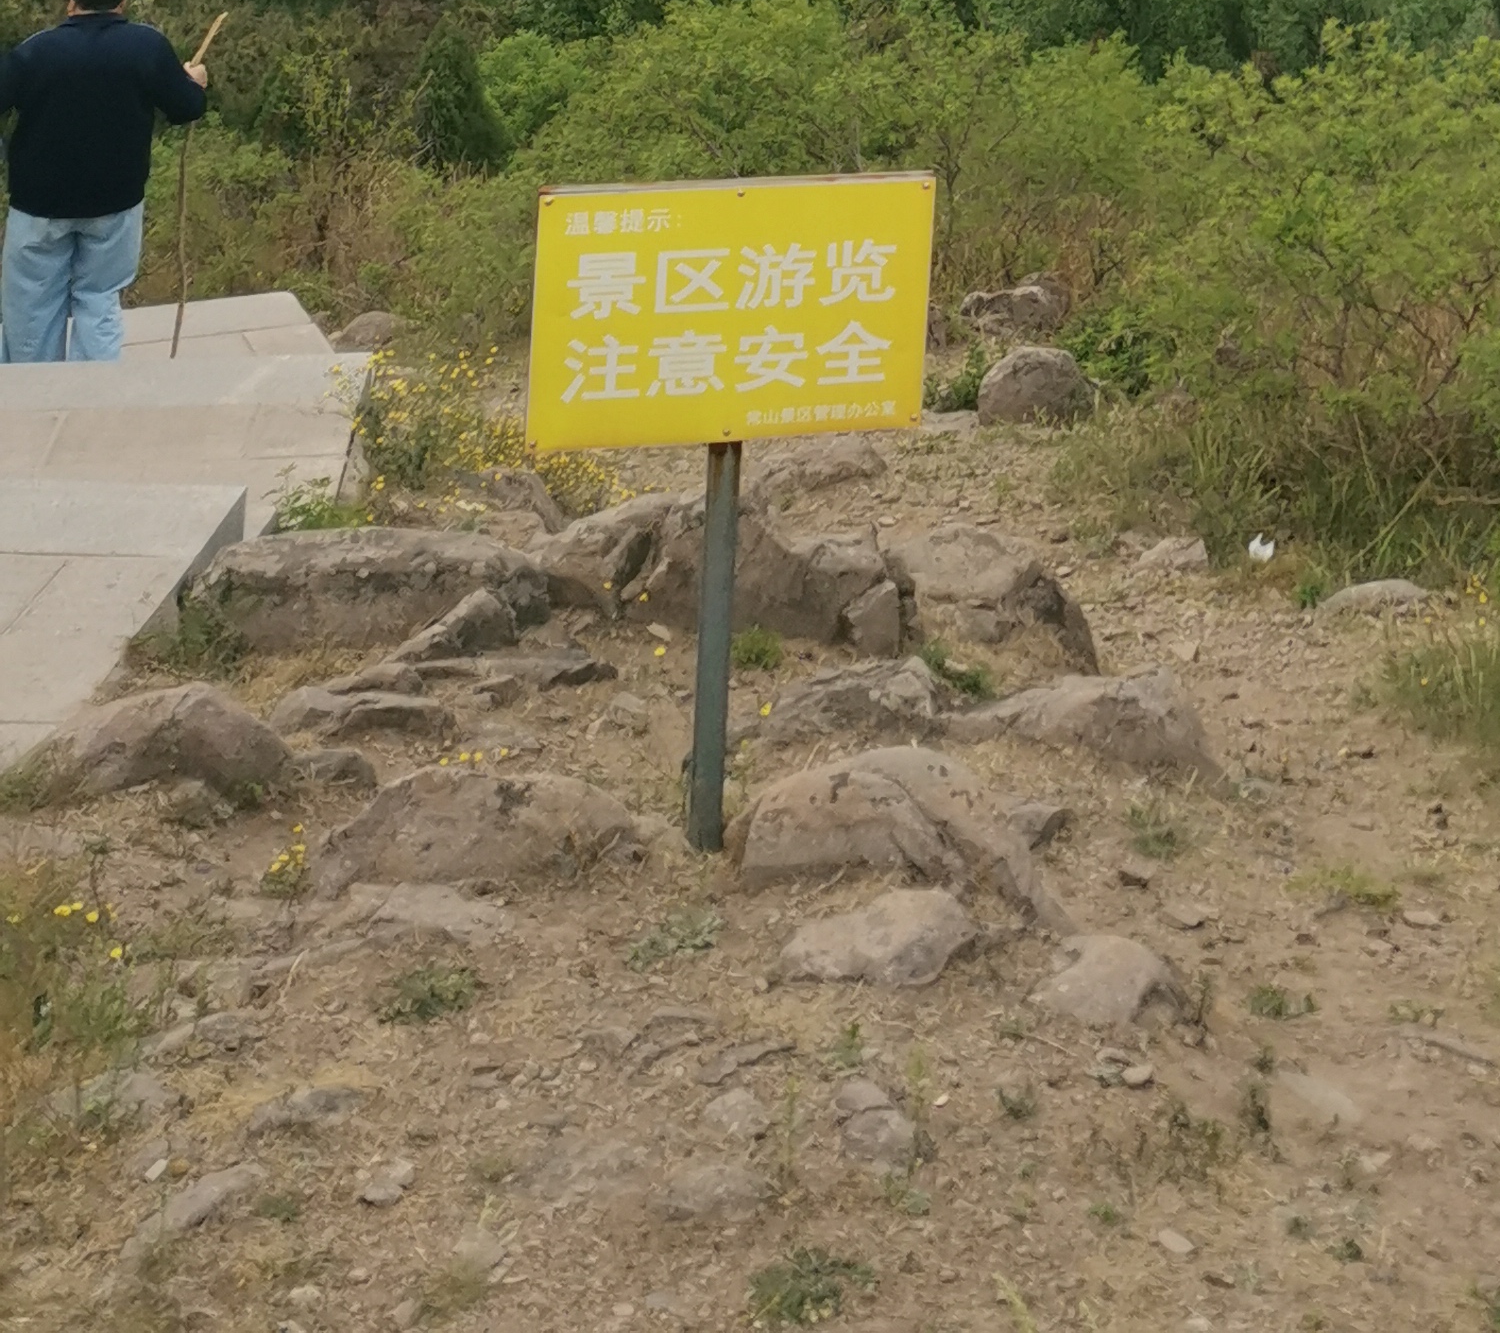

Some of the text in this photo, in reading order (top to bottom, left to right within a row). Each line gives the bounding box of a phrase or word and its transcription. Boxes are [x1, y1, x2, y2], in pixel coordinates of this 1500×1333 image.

[564, 238, 898, 320] 景区游览
[560, 319, 893, 404] 注意安全
